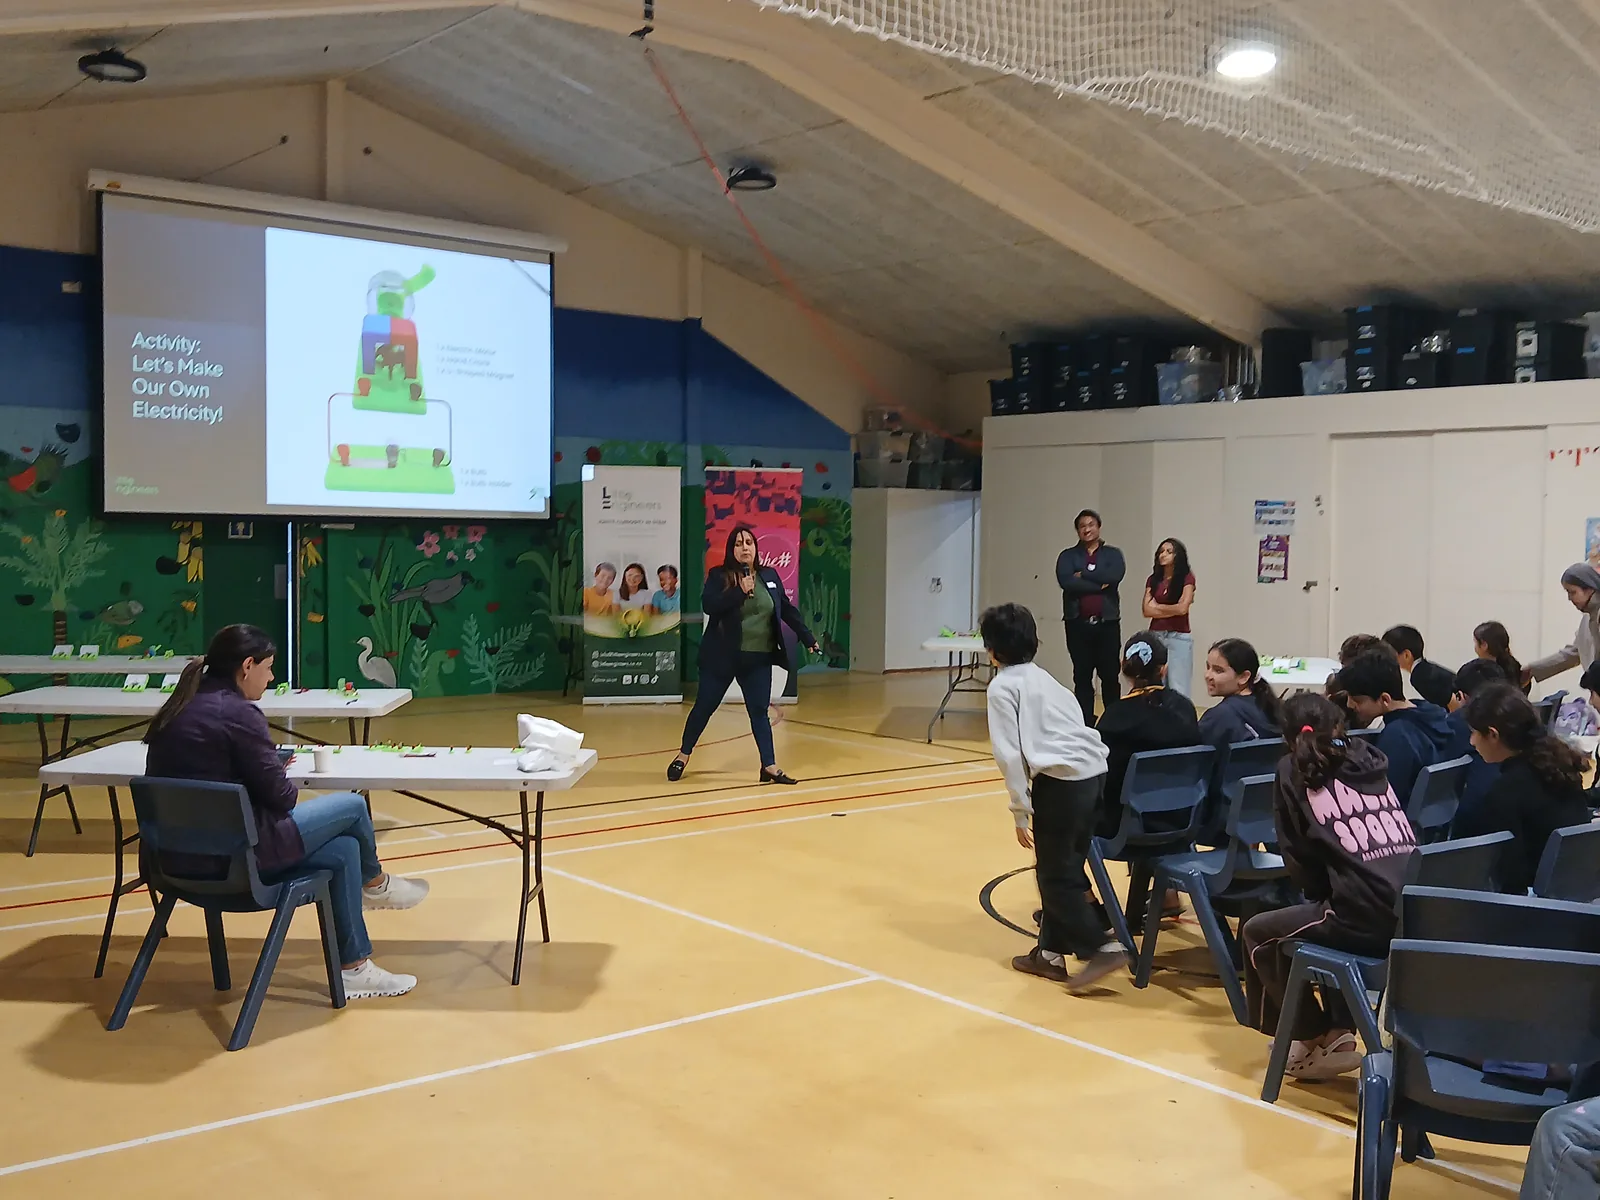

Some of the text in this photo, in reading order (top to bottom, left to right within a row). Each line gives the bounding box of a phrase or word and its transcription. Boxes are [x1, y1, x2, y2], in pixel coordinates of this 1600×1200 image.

[131, 331, 201, 356] Activity:
[132, 354, 224, 377] Let's Make
[131, 377, 210, 399] Our Own
[132, 400, 223, 425] Electricity!
